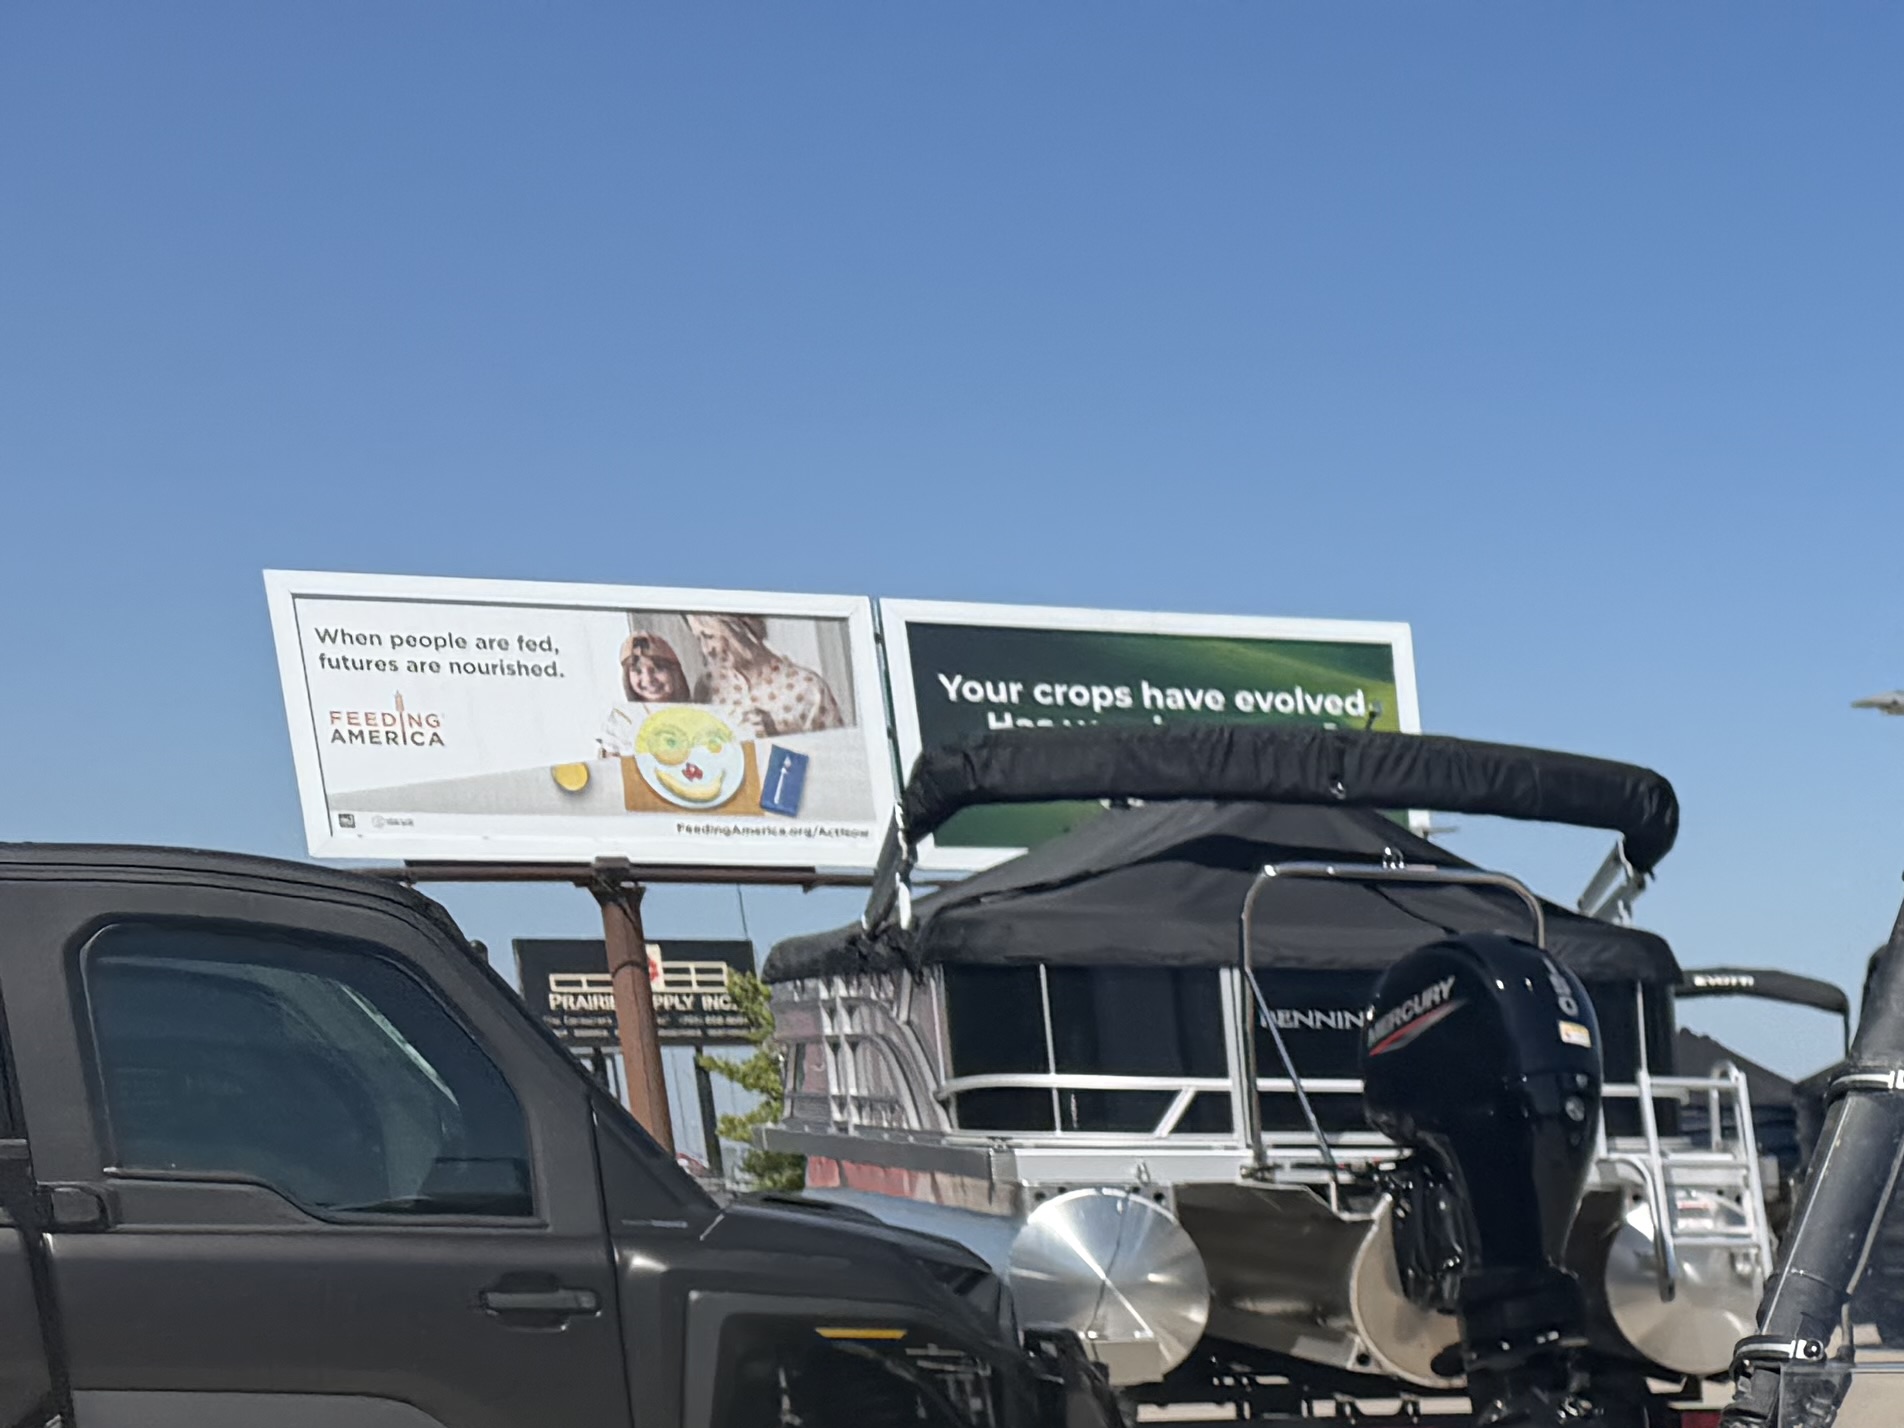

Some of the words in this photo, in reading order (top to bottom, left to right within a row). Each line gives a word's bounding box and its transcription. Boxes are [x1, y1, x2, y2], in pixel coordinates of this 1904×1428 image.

[314, 627, 383, 647] When
[390, 631, 468, 652] people
[475, 637, 510, 651] are
[517, 634, 559, 656] fed,
[318, 652, 399, 672] futures
[406, 659, 441, 674] are
[448, 658, 566, 678] nourished.
[937, 672, 1024, 705] Your
[1032, 682, 1134, 714] crops
[1141, 679, 1226, 712] have
[329, 707, 442, 729] FEEDING
[330, 728, 445, 747] AMERICA
[548, 993, 616, 1011] PRAIRI
[652, 993, 694, 1012] PPLY
[1260, 1008, 1364, 1030] BENNIN
